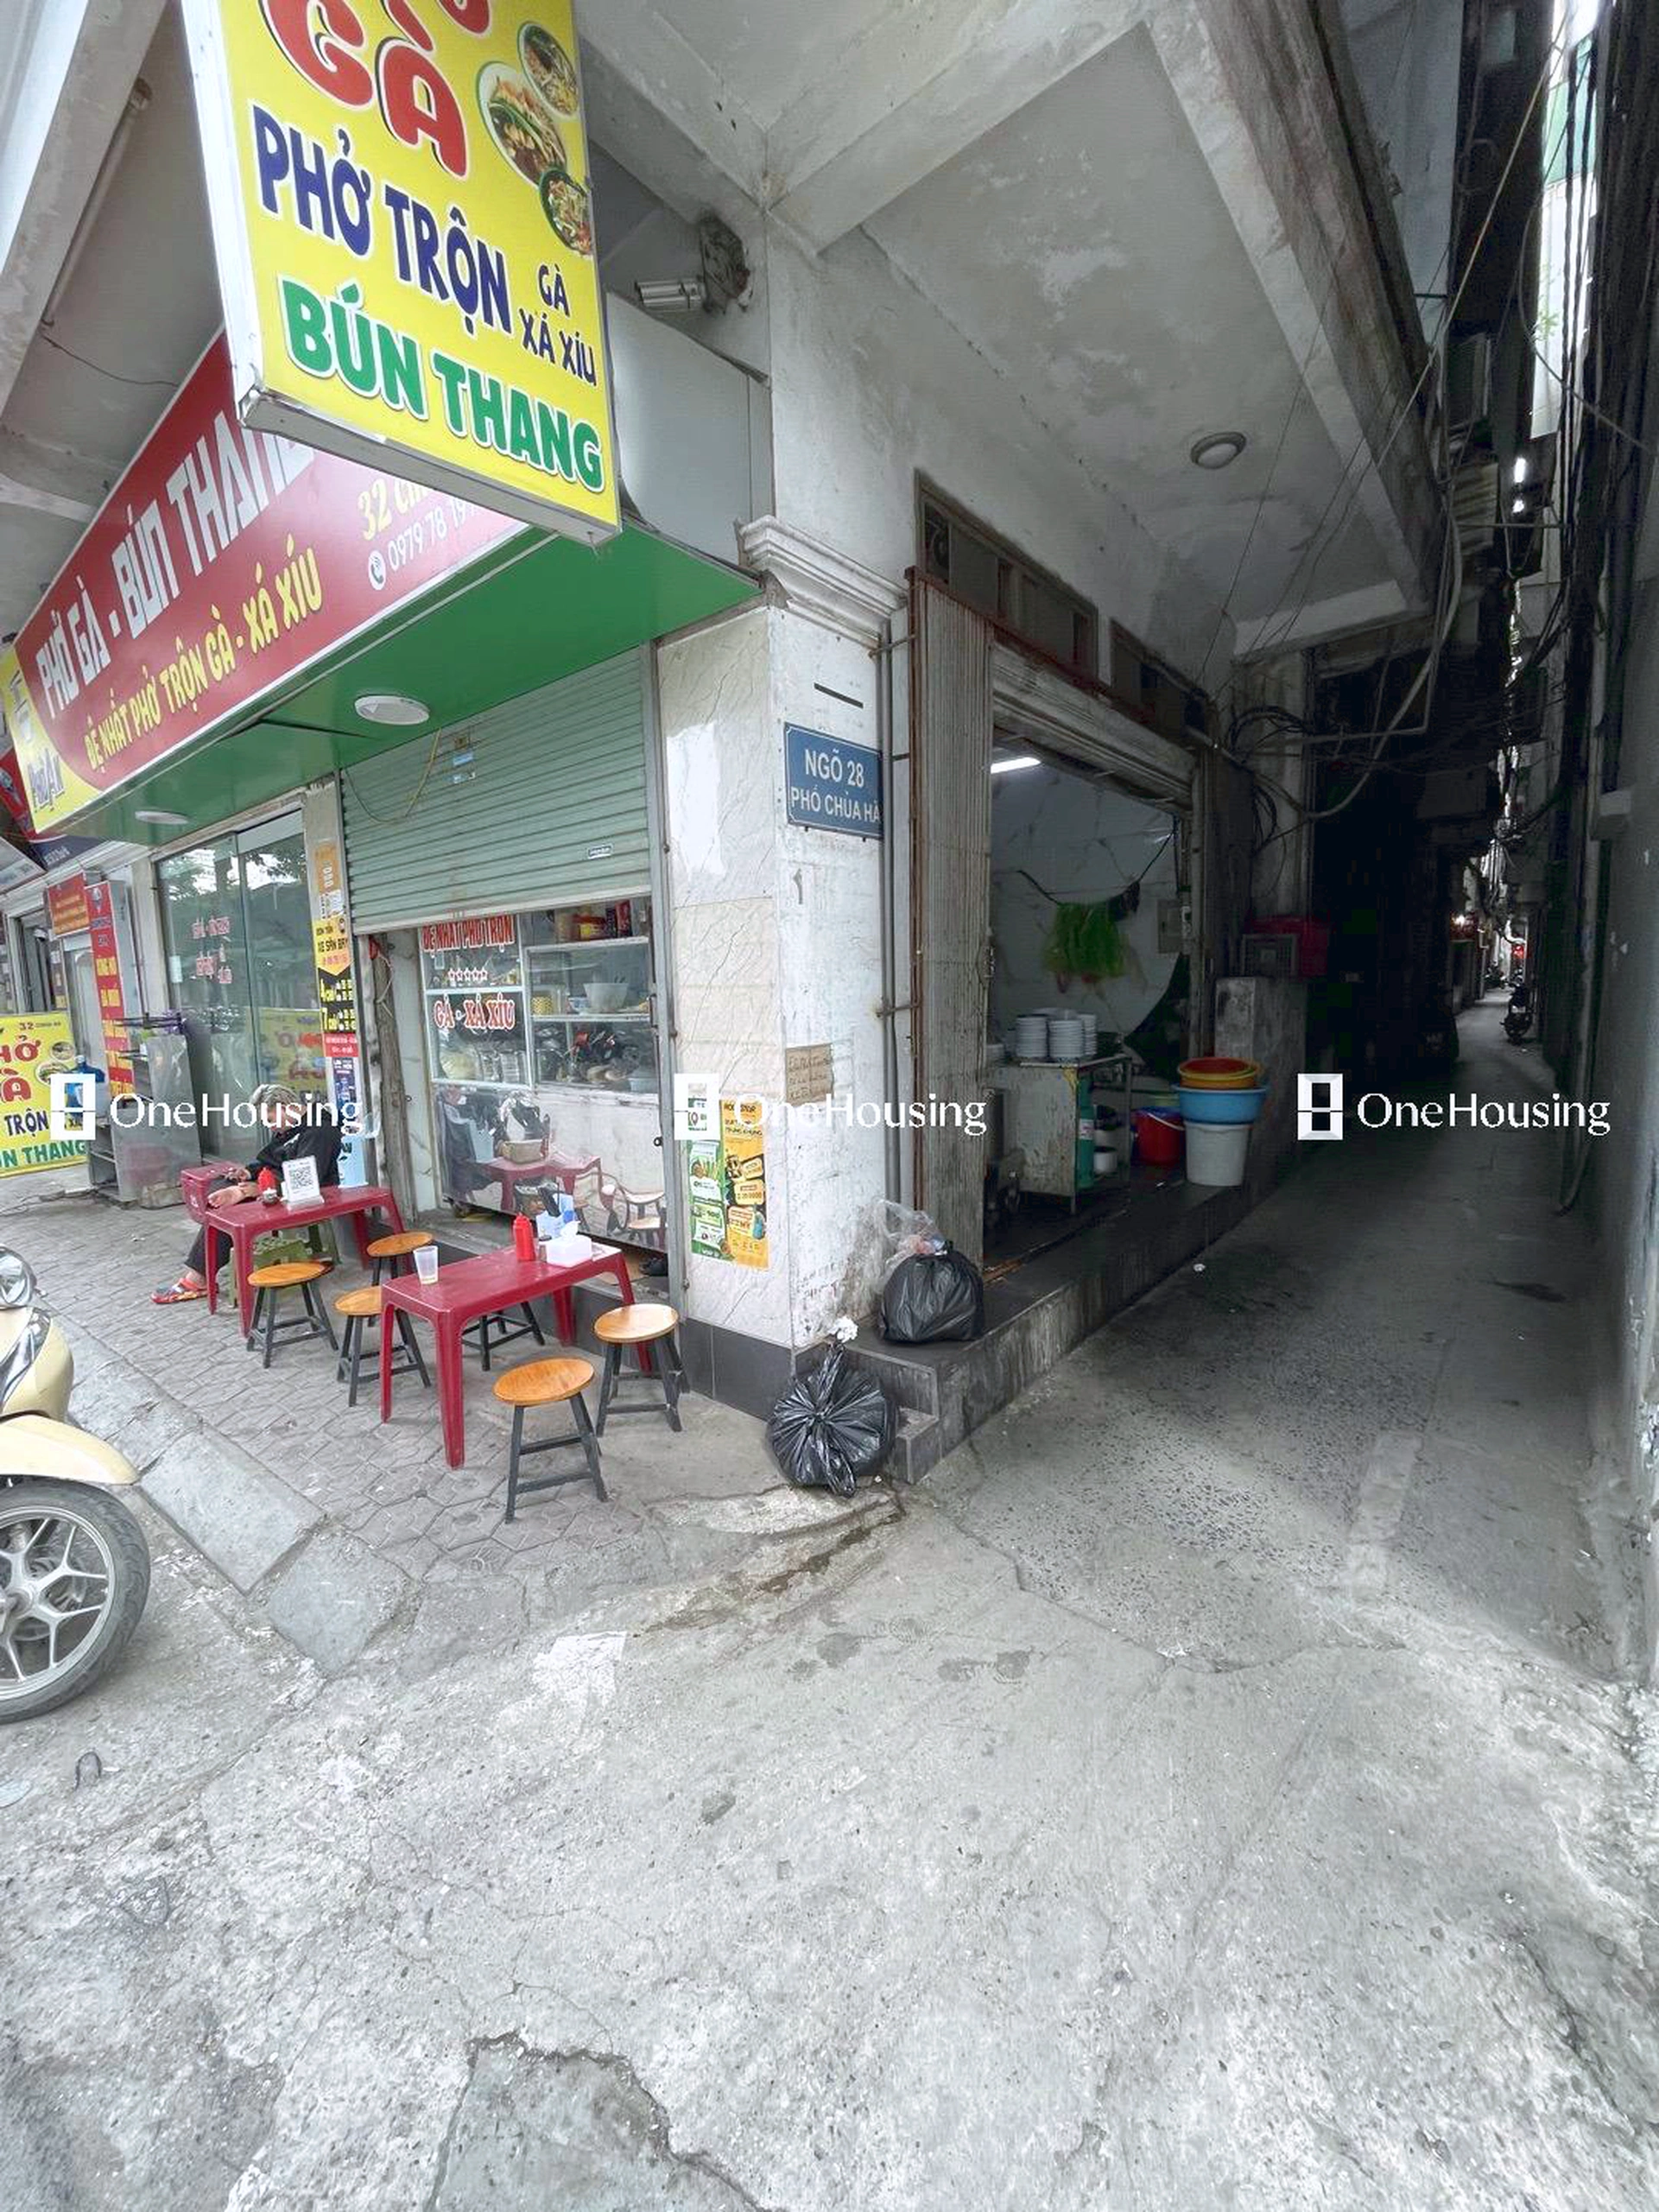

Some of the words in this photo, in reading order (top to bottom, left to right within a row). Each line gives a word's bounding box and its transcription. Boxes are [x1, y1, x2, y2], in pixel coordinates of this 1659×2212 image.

[253, 105, 370, 256] PHỞ
[385, 184, 512, 335] TRỘN
[538, 263, 570, 318] GÀ
[519, 308, 555, 364] XÁ
[559, 331, 597, 386] XÍU
[282, 281, 425, 417] BÚN
[434, 353, 604, 490] THANG
[358, 479, 392, 541] 32
[389, 523, 423, 571] 0979
[426, 507, 447, 548] 78
[35, 610, 79, 719] PHỞ
[67, 575, 111, 686] GÀ
[111, 500, 180, 639] BÚN
[130, 664, 161, 737] PHỞ
[159, 636, 208, 713] TRỘN
[206, 604, 236, 681] GÀ
[243, 562, 279, 654] XÁ
[275, 533, 322, 630] XÍU
[805, 748, 843, 783] NGÕ
[847, 761, 864, 788] 28
[791, 784, 821, 812] PHỐ
[825, 791, 862, 821] CHÙA
[434, 992, 455, 1028] GÀ
[464, 992, 486, 1030] XÁ
[485, 992, 516, 1030] XÍU
[0, 1035, 41, 1063] HỞ
[0, 1068, 32, 1102] À
[4, 1108, 49, 1138] TRỘN
[22, 1140, 86, 1164] THANG
